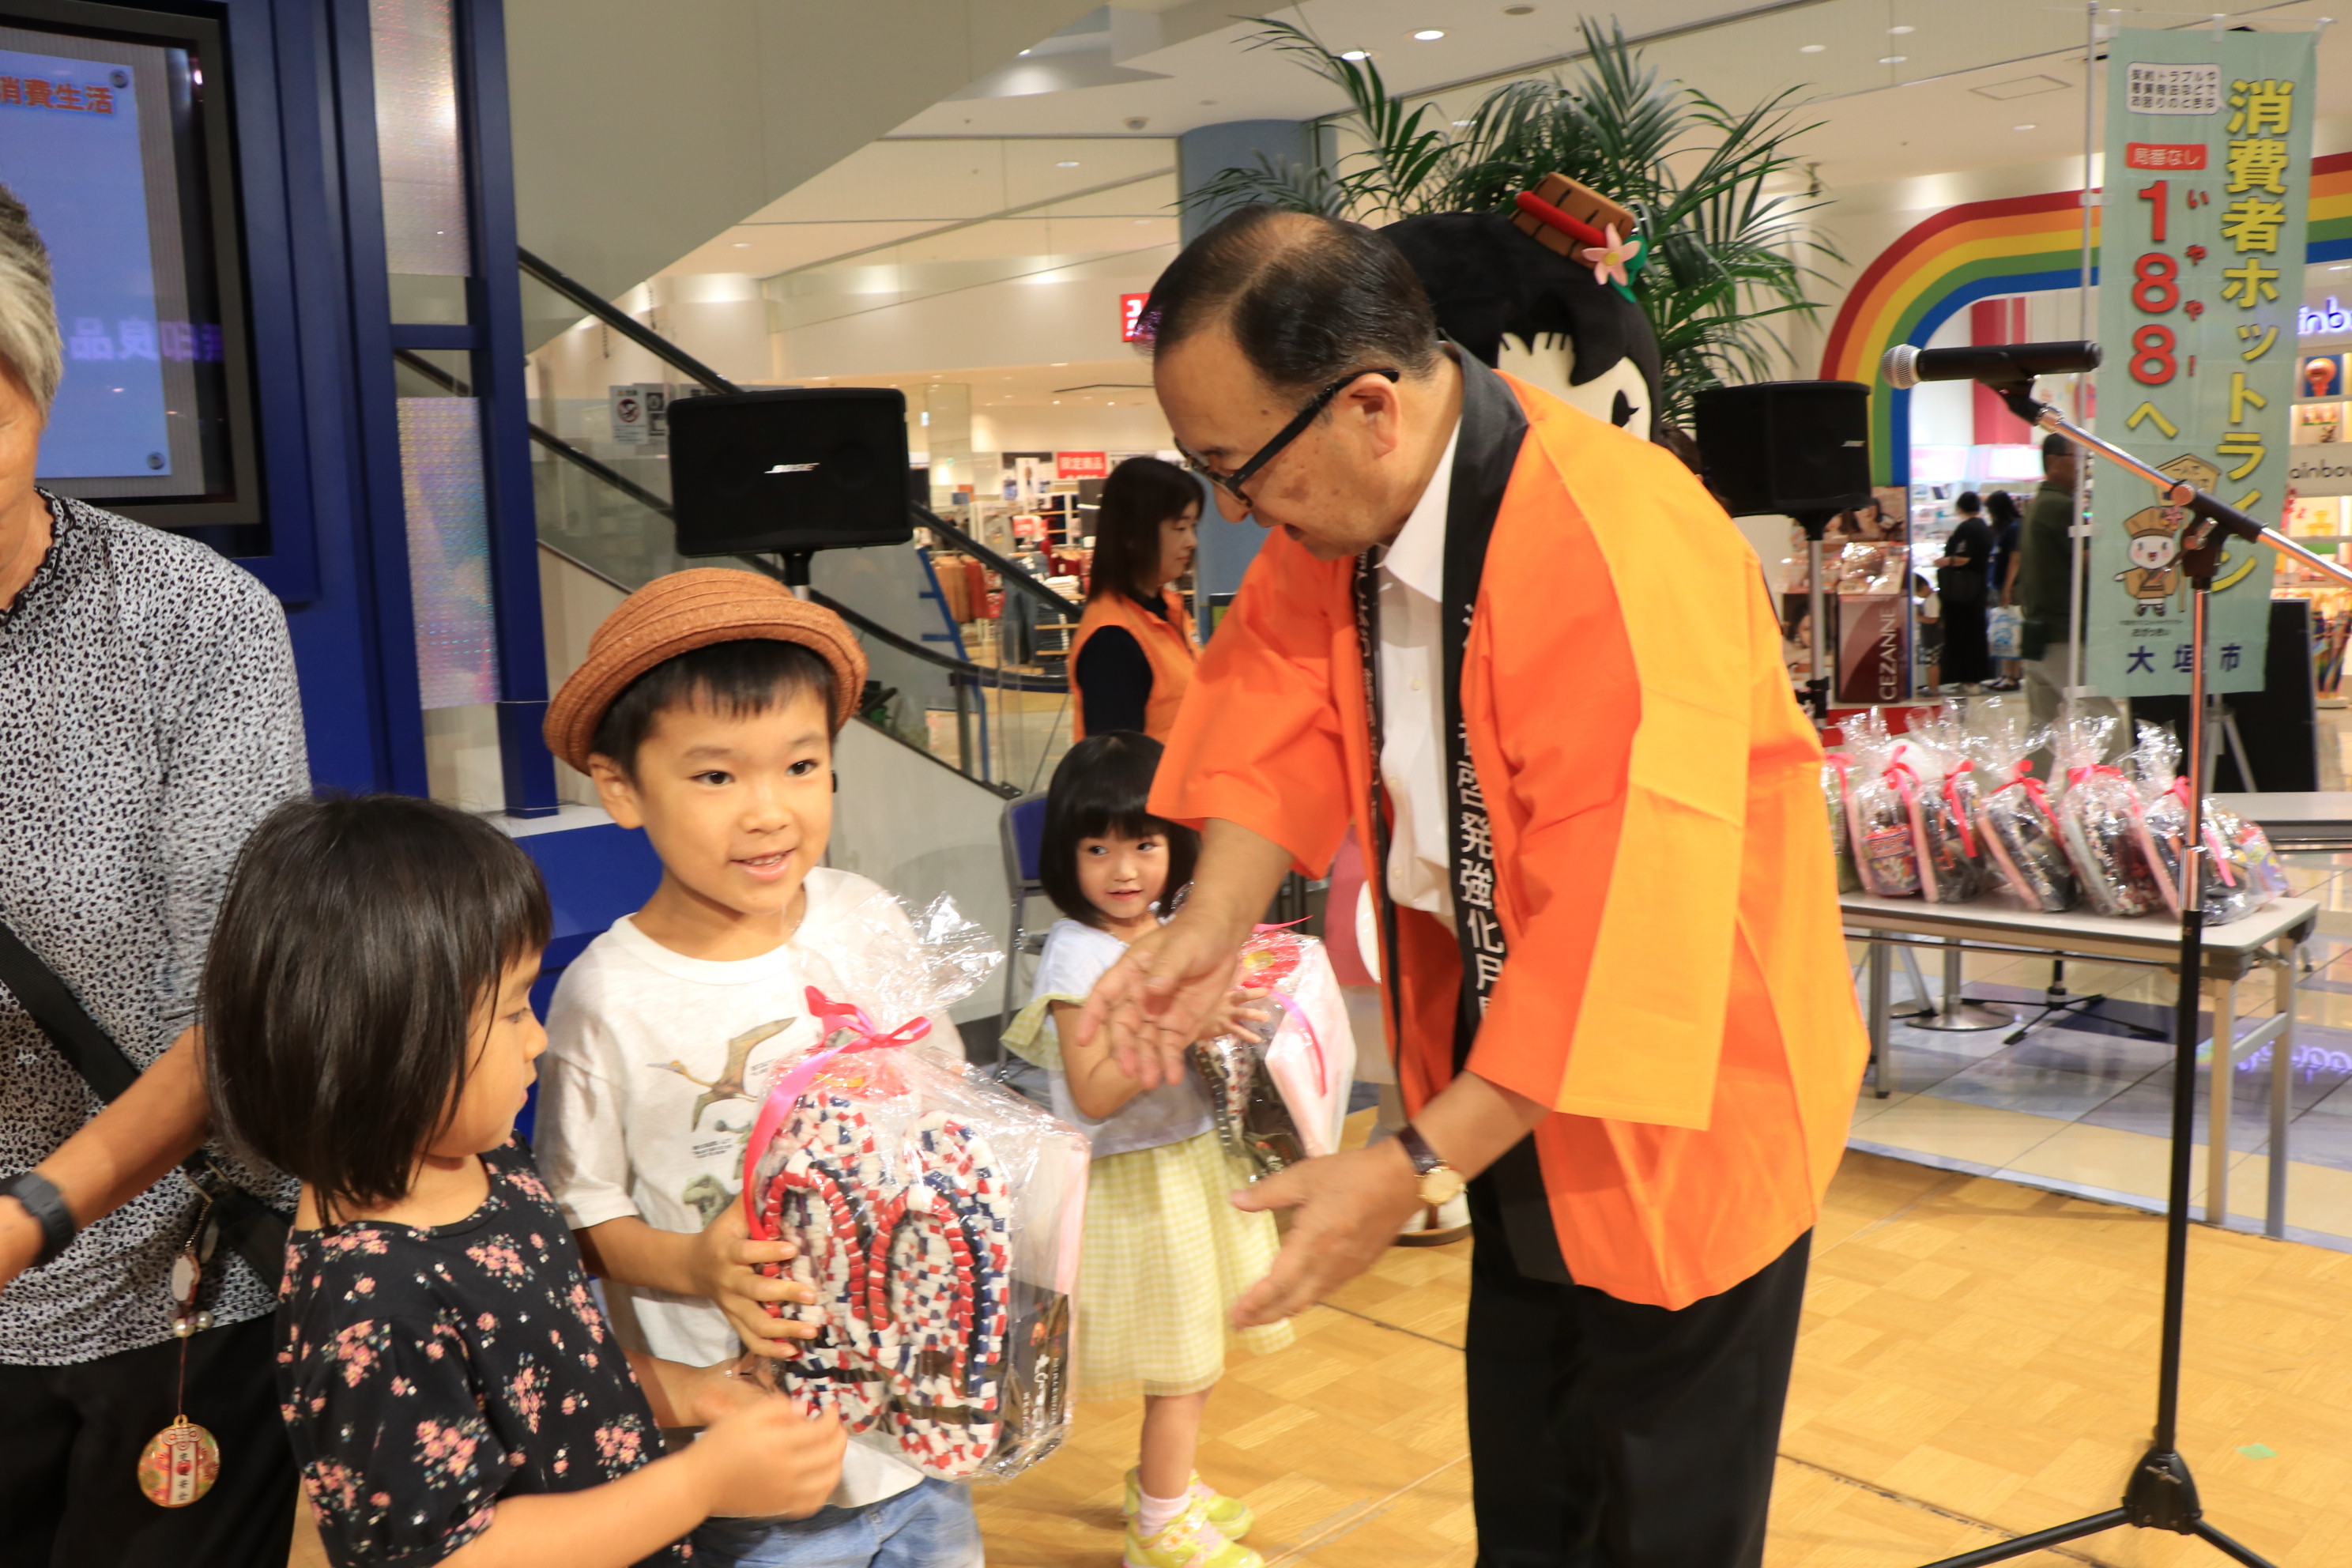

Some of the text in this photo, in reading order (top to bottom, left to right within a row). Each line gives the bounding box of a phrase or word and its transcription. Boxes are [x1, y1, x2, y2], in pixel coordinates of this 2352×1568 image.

[0, 77, 113, 115] 消費生活
[2210, 78, 2296, 594] 消費者ホットラン
[2297, 296, 2352, 335] inb
[1879, 607, 1898, 701] CEZANNE
